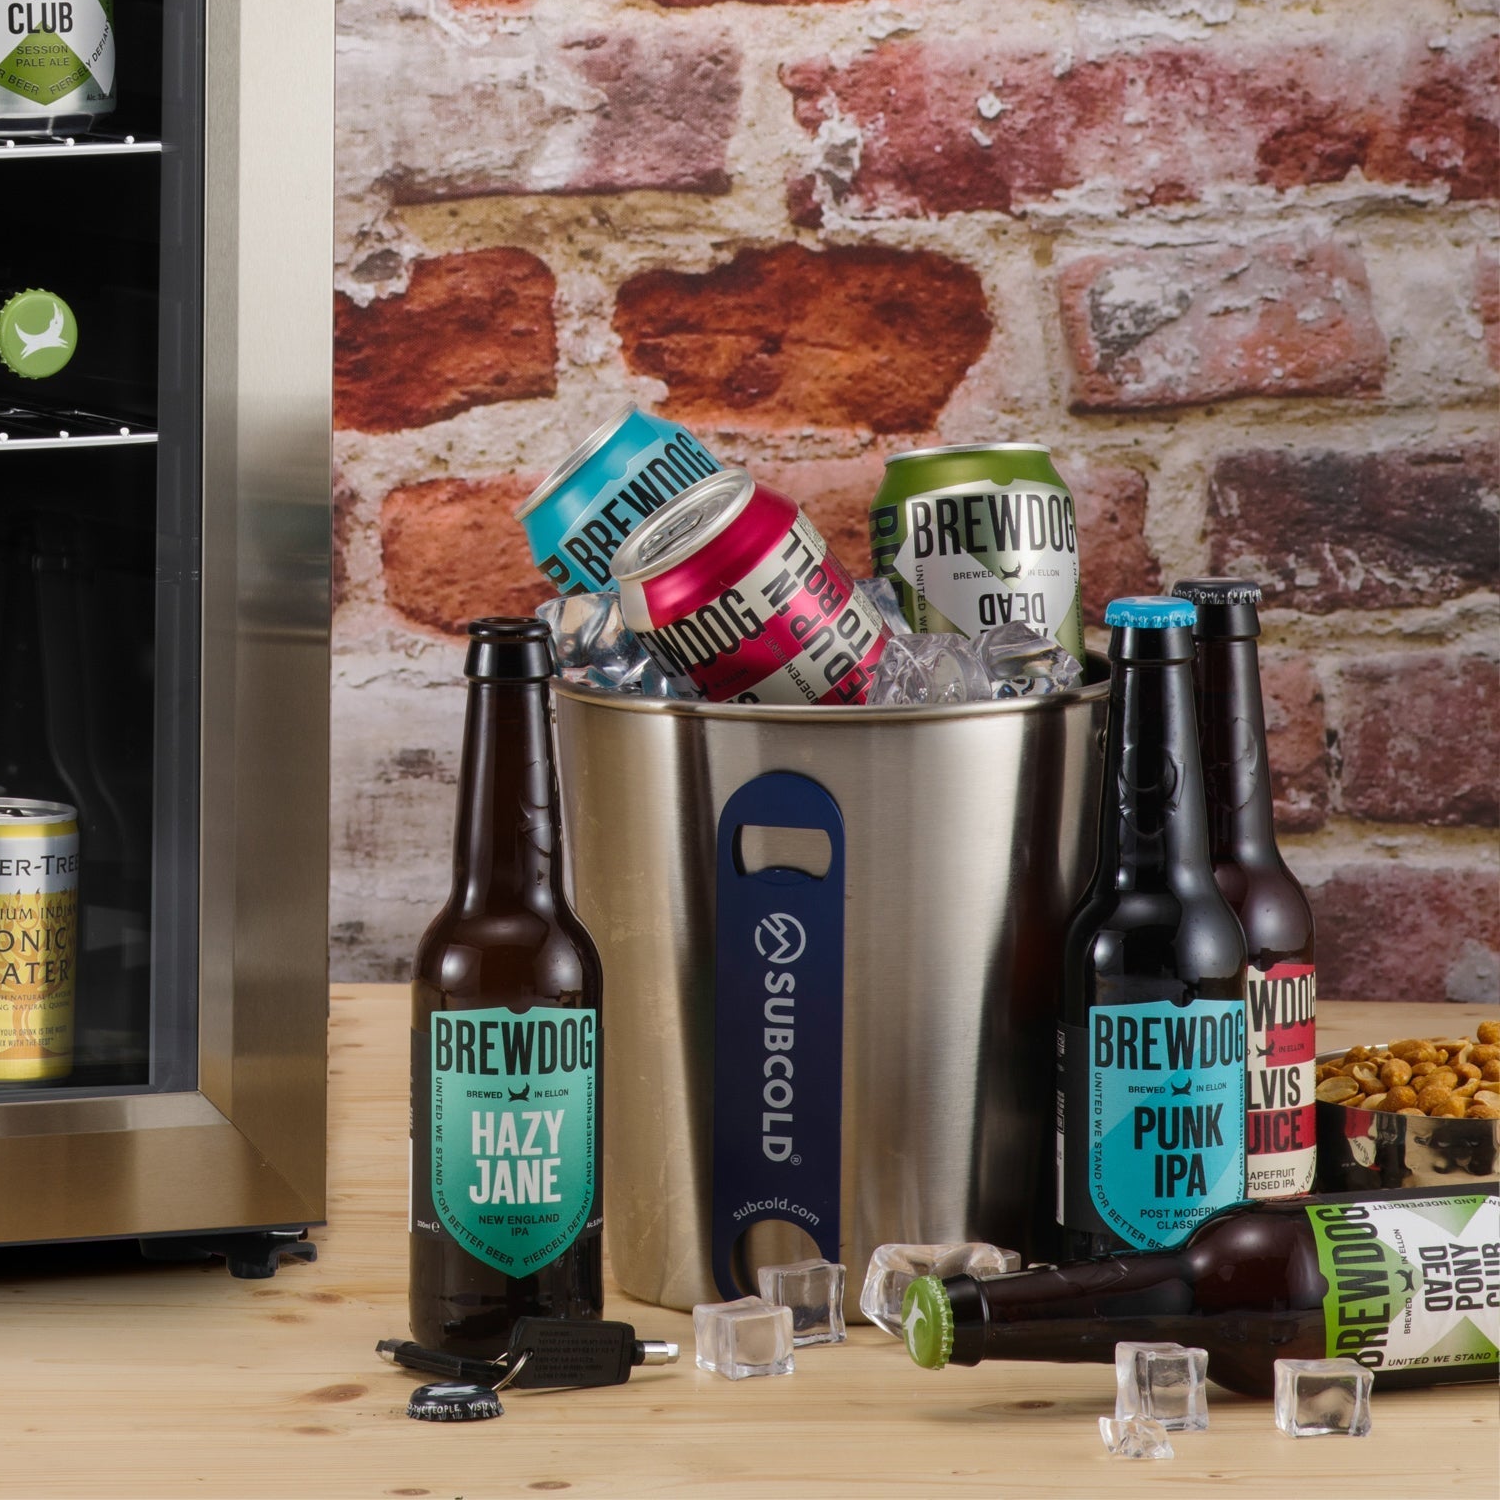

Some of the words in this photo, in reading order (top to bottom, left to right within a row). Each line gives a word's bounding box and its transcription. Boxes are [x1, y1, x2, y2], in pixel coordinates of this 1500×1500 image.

[8, 2, 73, 35] CLUB
[16, 45, 68, 55] SESSION
[16, 58, 45, 67] PALE
[49, 57, 70, 67] ALE
[911, 493, 1076, 559] BREWDOG
[953, 570, 994, 580] BREWED
[978, 592, 1047, 626] DEAD
[10, 992, 46, 1000] NATURAL
[12, 1002, 47, 1011] NATURAL
[435, 1014, 593, 1076] BREWDOG
[1094, 1008, 1244, 1071] BREWDOG
[466, 1090, 503, 1100] BREWED
[534, 1089, 543, 1098] IN
[544, 1088, 569, 1098] ELLON
[1128, 1085, 1166, 1094] BREWED
[1248, 1066, 1302, 1110] LVIS
[471, 1109, 565, 1156] HAZY
[1133, 1102, 1224, 1150] PUNK
[469, 1157, 562, 1205] JANE
[1154, 1153, 1208, 1199] IPA
[478, 1215, 506, 1225] NEW
[507, 1213, 560, 1225] ENGLAND
[733, 1197, 821, 1226] subcold.com
[1140, 1208, 1170, 1219] POST
[1173, 1206, 1218, 1219] MODERN
[511, 1226, 529, 1237] IPA
[1316, 1206, 1390, 1369] BREWDOG
[1418, 1245, 1453, 1312] DEAD
[1449, 1242, 1484, 1311] PONY
[1403, 1297, 1413, 1335] BREWED
[1388, 1356, 1429, 1367] UNITED
[1433, 1355, 1451, 1363] WE
[1455, 1351, 1491, 1361] STAND
